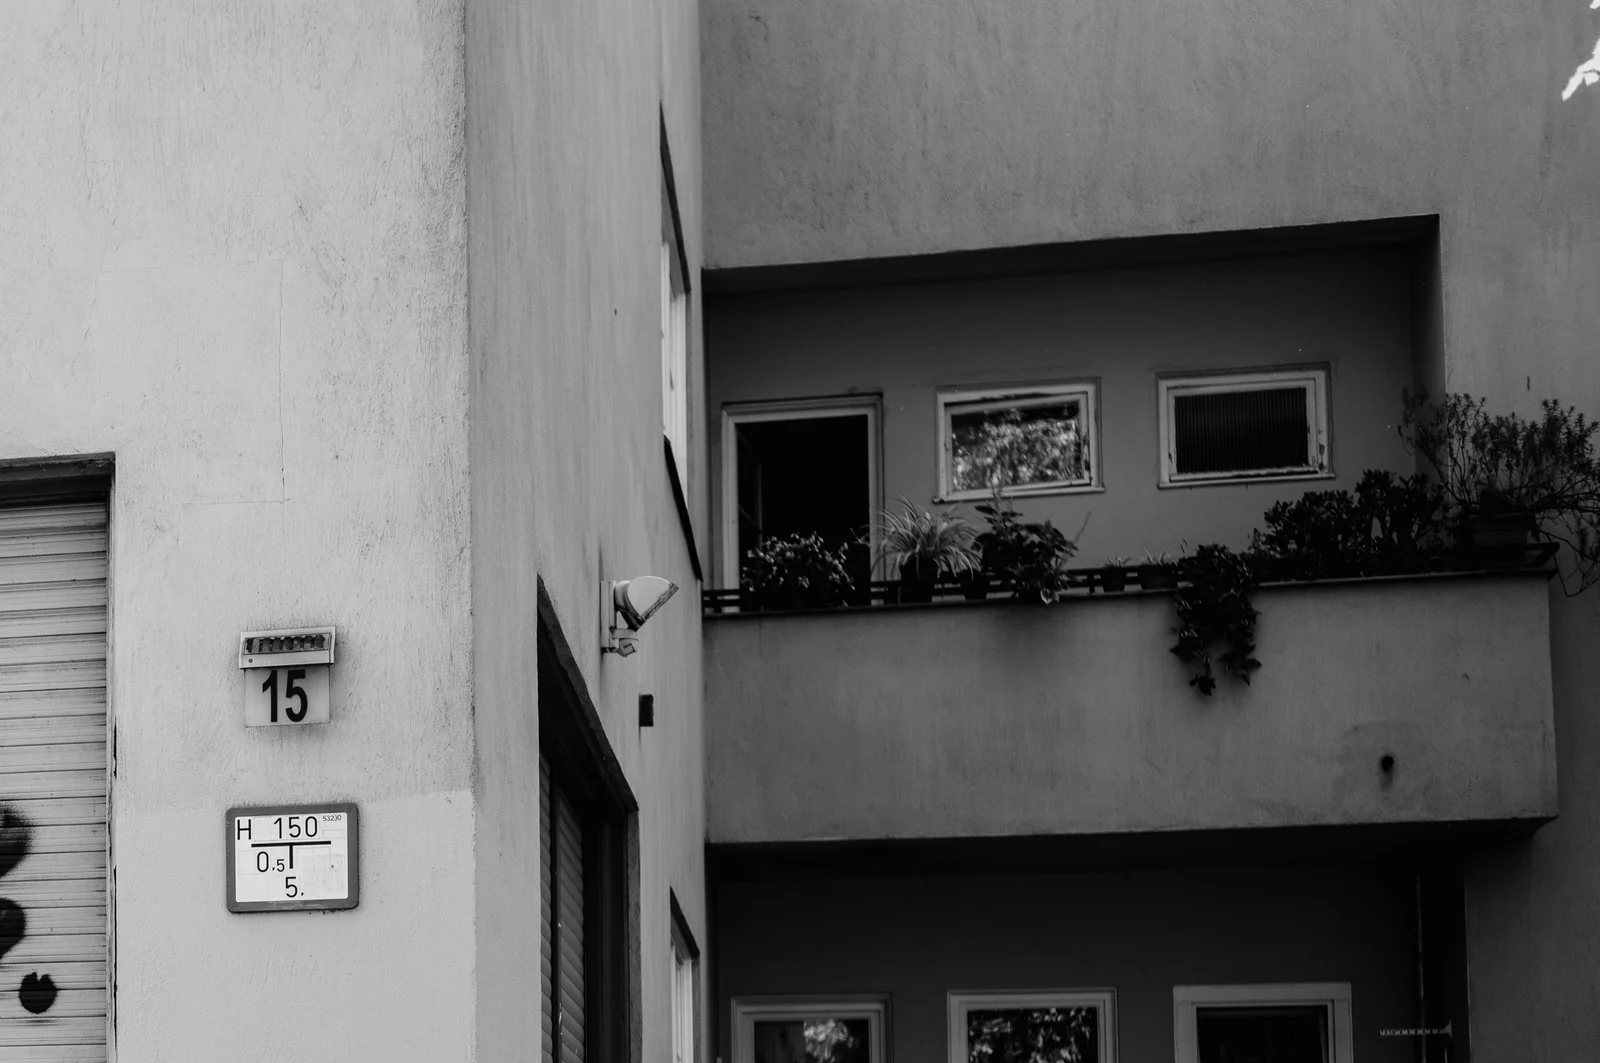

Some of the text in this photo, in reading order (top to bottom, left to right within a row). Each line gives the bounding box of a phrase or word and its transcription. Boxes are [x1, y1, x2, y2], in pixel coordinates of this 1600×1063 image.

[262, 668, 308, 723] 15
[237, 815, 318, 841] H 150
